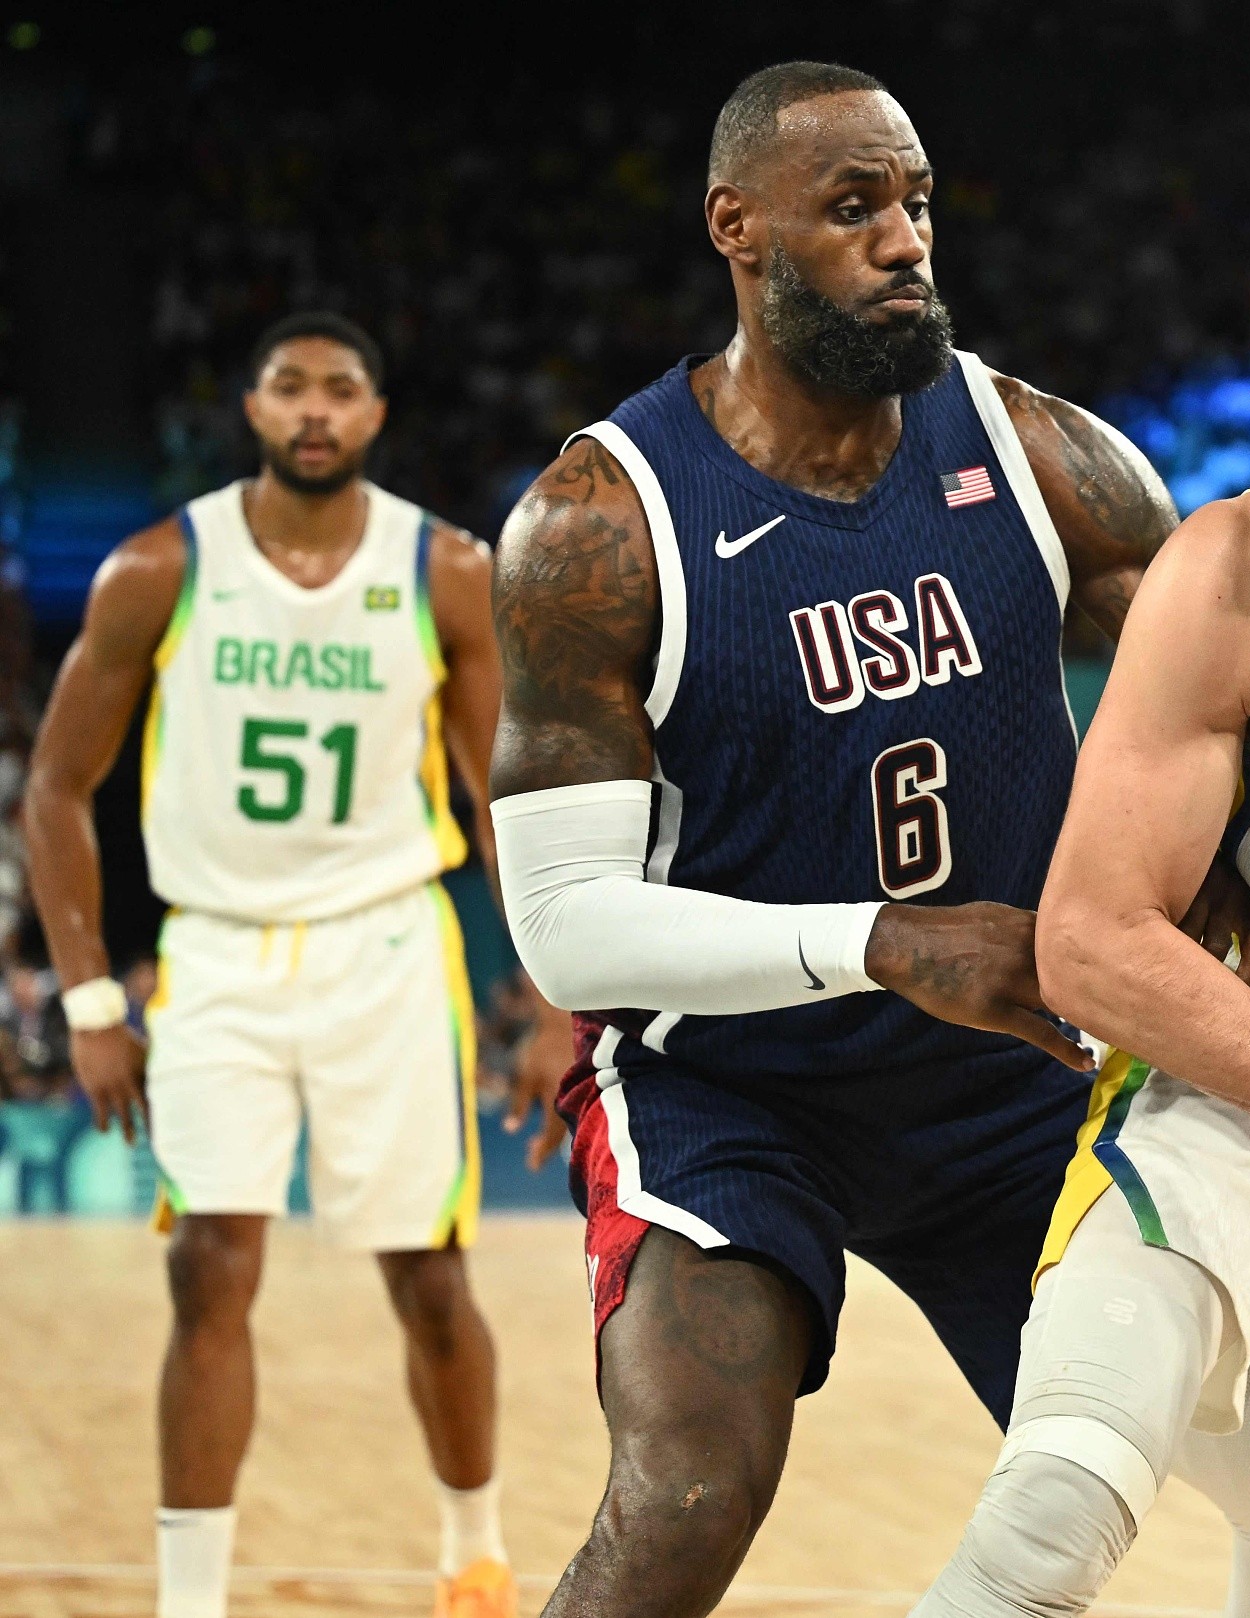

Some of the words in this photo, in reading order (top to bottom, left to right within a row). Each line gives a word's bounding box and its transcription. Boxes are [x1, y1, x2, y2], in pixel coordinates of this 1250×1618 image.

[215, 637, 386, 692] BRASIL
[789, 572, 983, 714] USA
[238, 717, 358, 826] 51
[870, 737, 952, 900] 6
